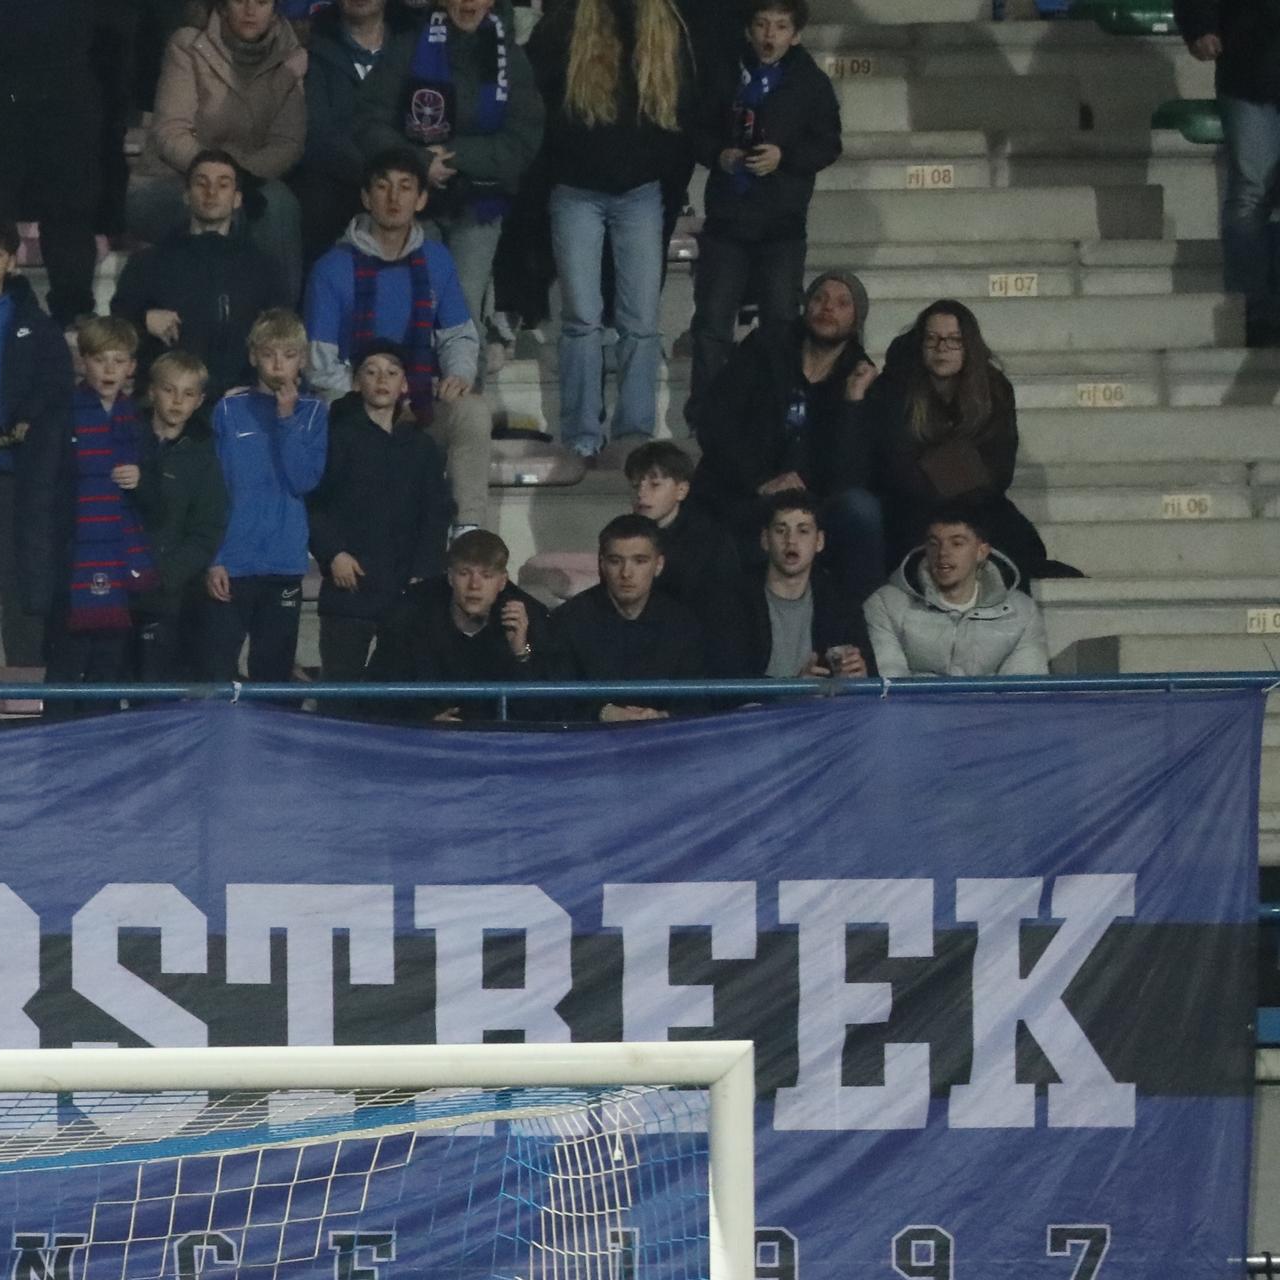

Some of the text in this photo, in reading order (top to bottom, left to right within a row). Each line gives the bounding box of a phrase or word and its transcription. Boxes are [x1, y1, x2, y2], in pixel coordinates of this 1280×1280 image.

[850, 59, 872, 75] 09
[930, 169, 952, 185] 08
[991, 276, 1035, 295] rij 07
[1249, 612, 1267, 632] rij
